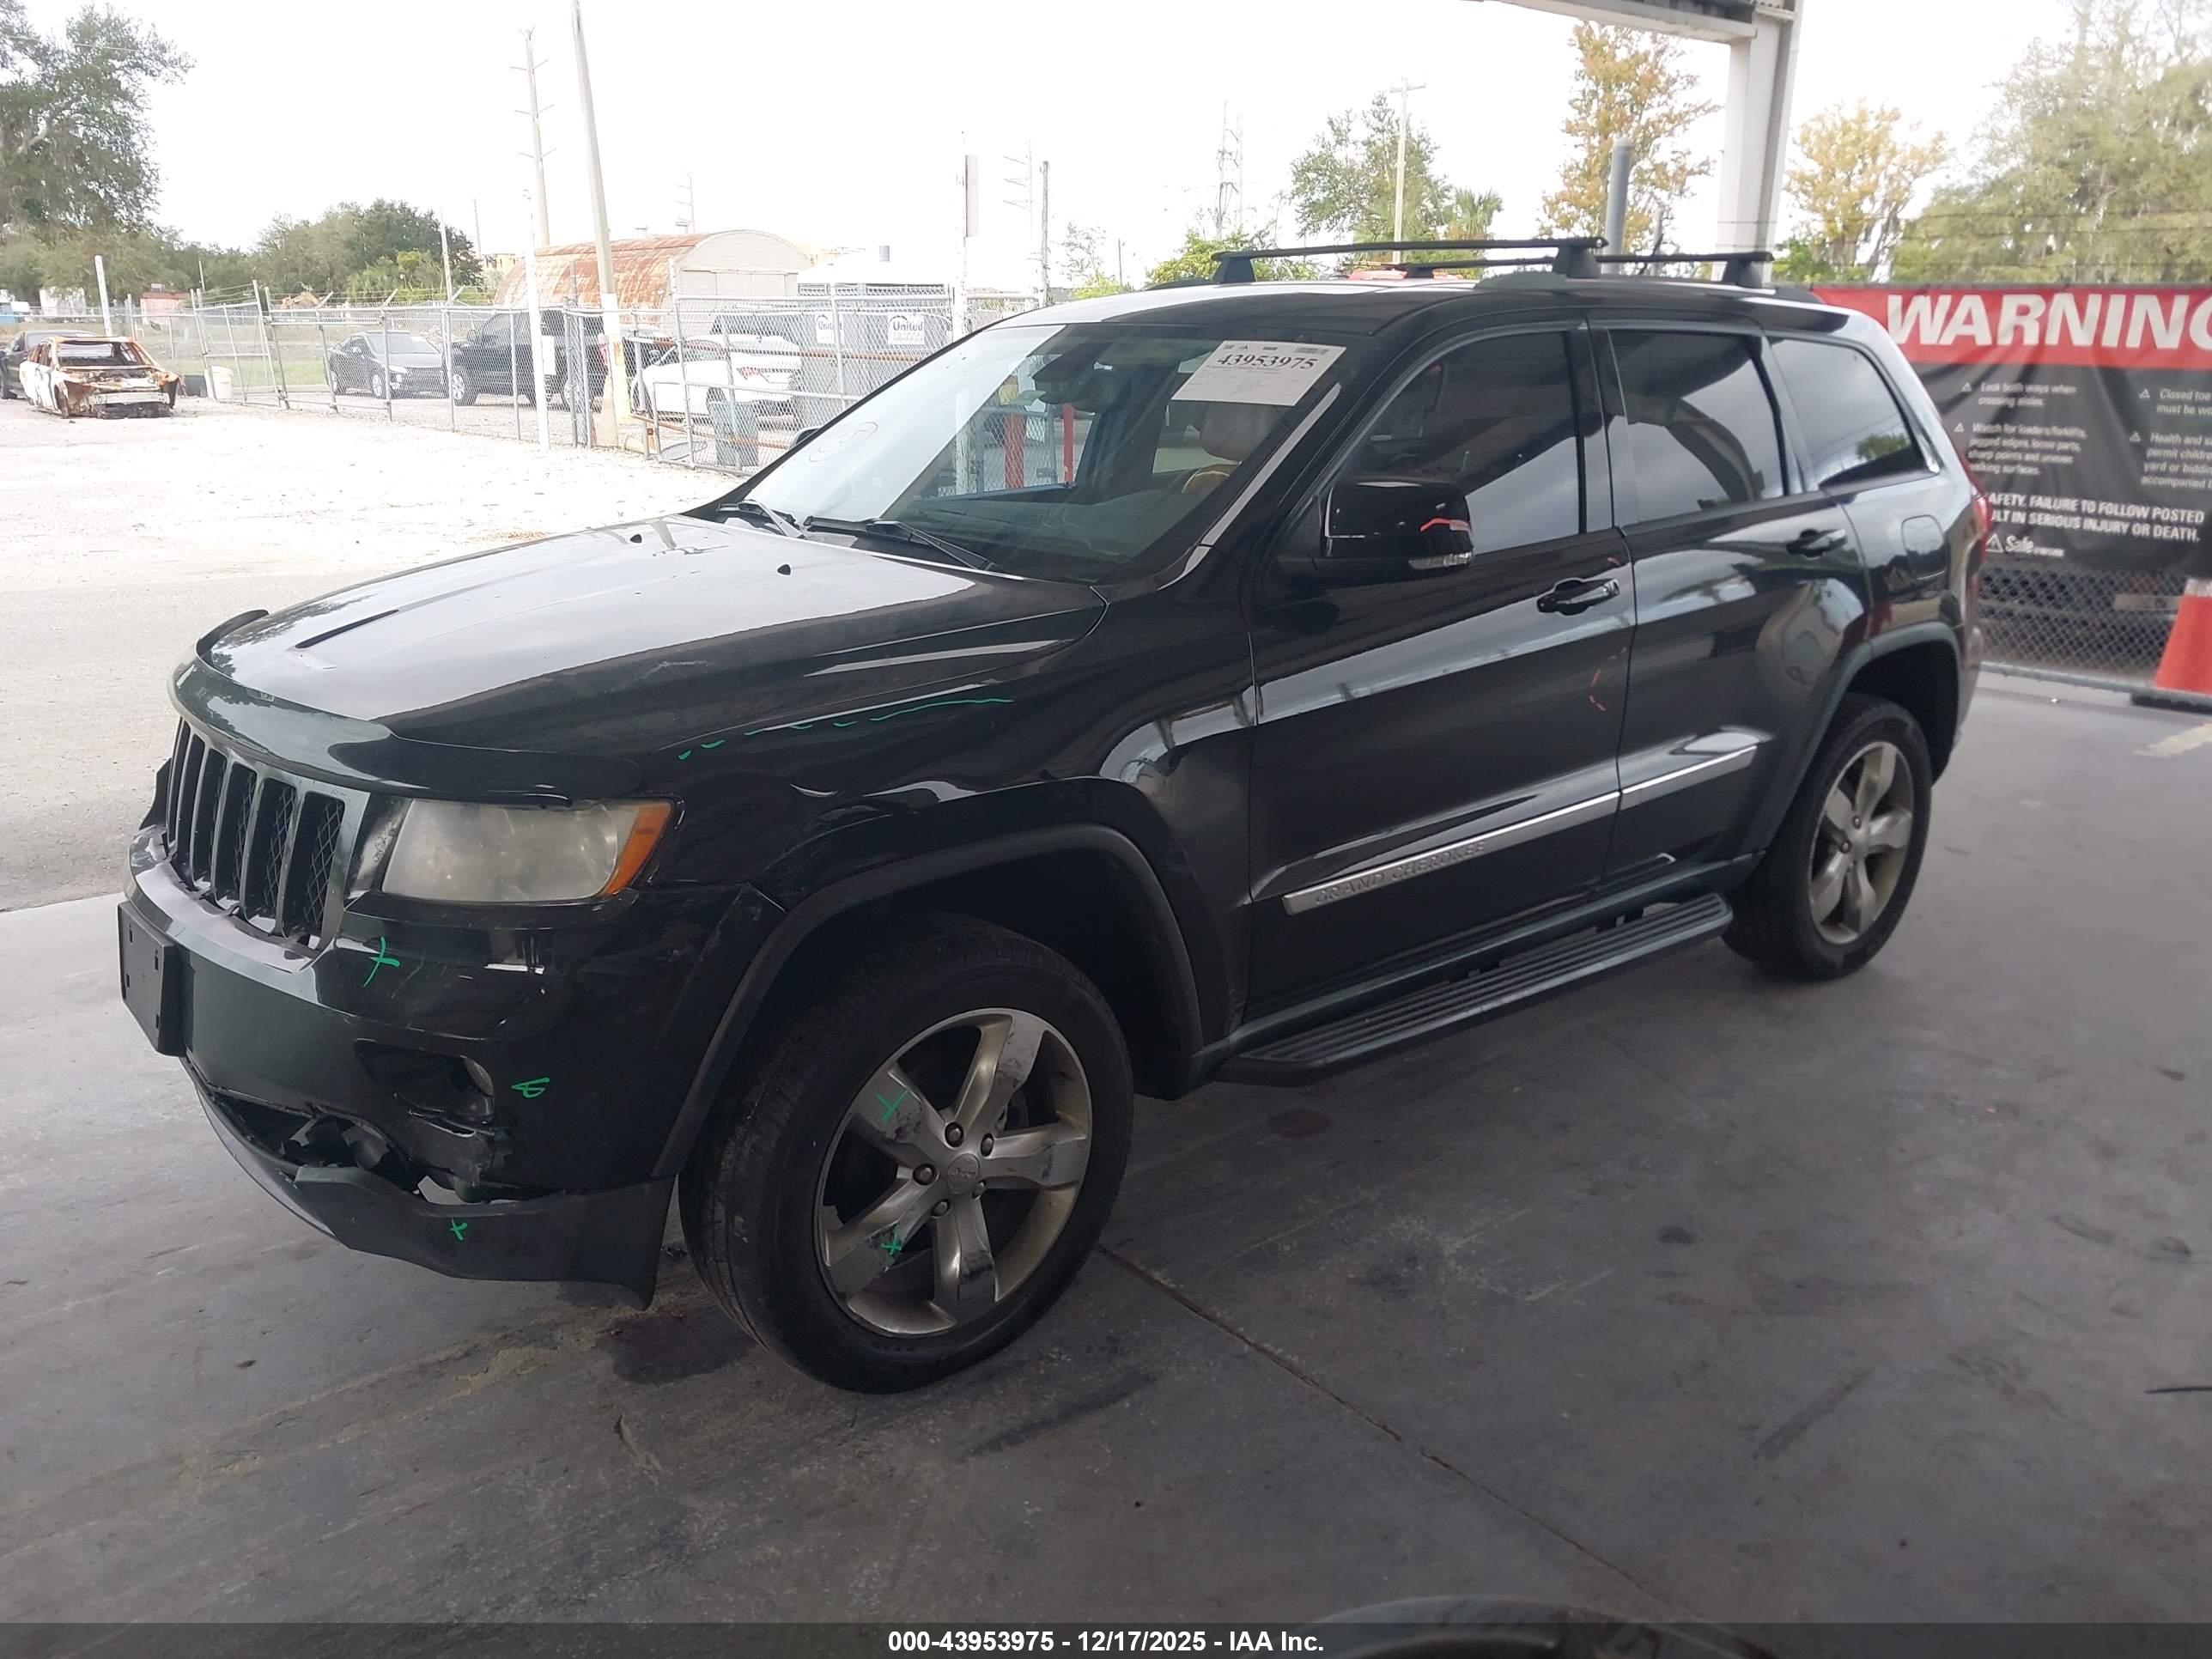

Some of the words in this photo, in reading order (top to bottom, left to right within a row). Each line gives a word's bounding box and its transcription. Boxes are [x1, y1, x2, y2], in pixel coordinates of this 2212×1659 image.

[893, 321, 923, 331] United
[1217, 353, 1318, 370] 43953975
[2160, 388, 2193, 399] Closed
[2195, 391, 2212, 401] toe
[2156, 404, 2182, 414] must
[2183, 404, 2197, 415] be
[2150, 432, 2182, 444] Health
[2184, 436, 2203, 446] and
[2146, 447, 2179, 459] permit
[2143, 461, 2167, 472] yard
[2141, 476, 2206, 489] accompanied
[1988, 493, 2027, 507] AFETY.
[2028, 495, 2080, 513] FAILURE
[2081, 499, 2097, 514] TO
[2098, 501, 2151, 519] FOLLOW
[2152, 507, 2206, 524] POSTED
[2011, 510, 2027, 524] IN
[2027, 512, 2082, 530] SERIOUS
[2082, 516, 2130, 534] INJURY
[2131, 521, 2152, 538] OR
[2152, 525, 2201, 543] DEATH.
[1315, 872, 1386, 905] GRAND
[1392, 841, 1485, 881] CHEROKEE
